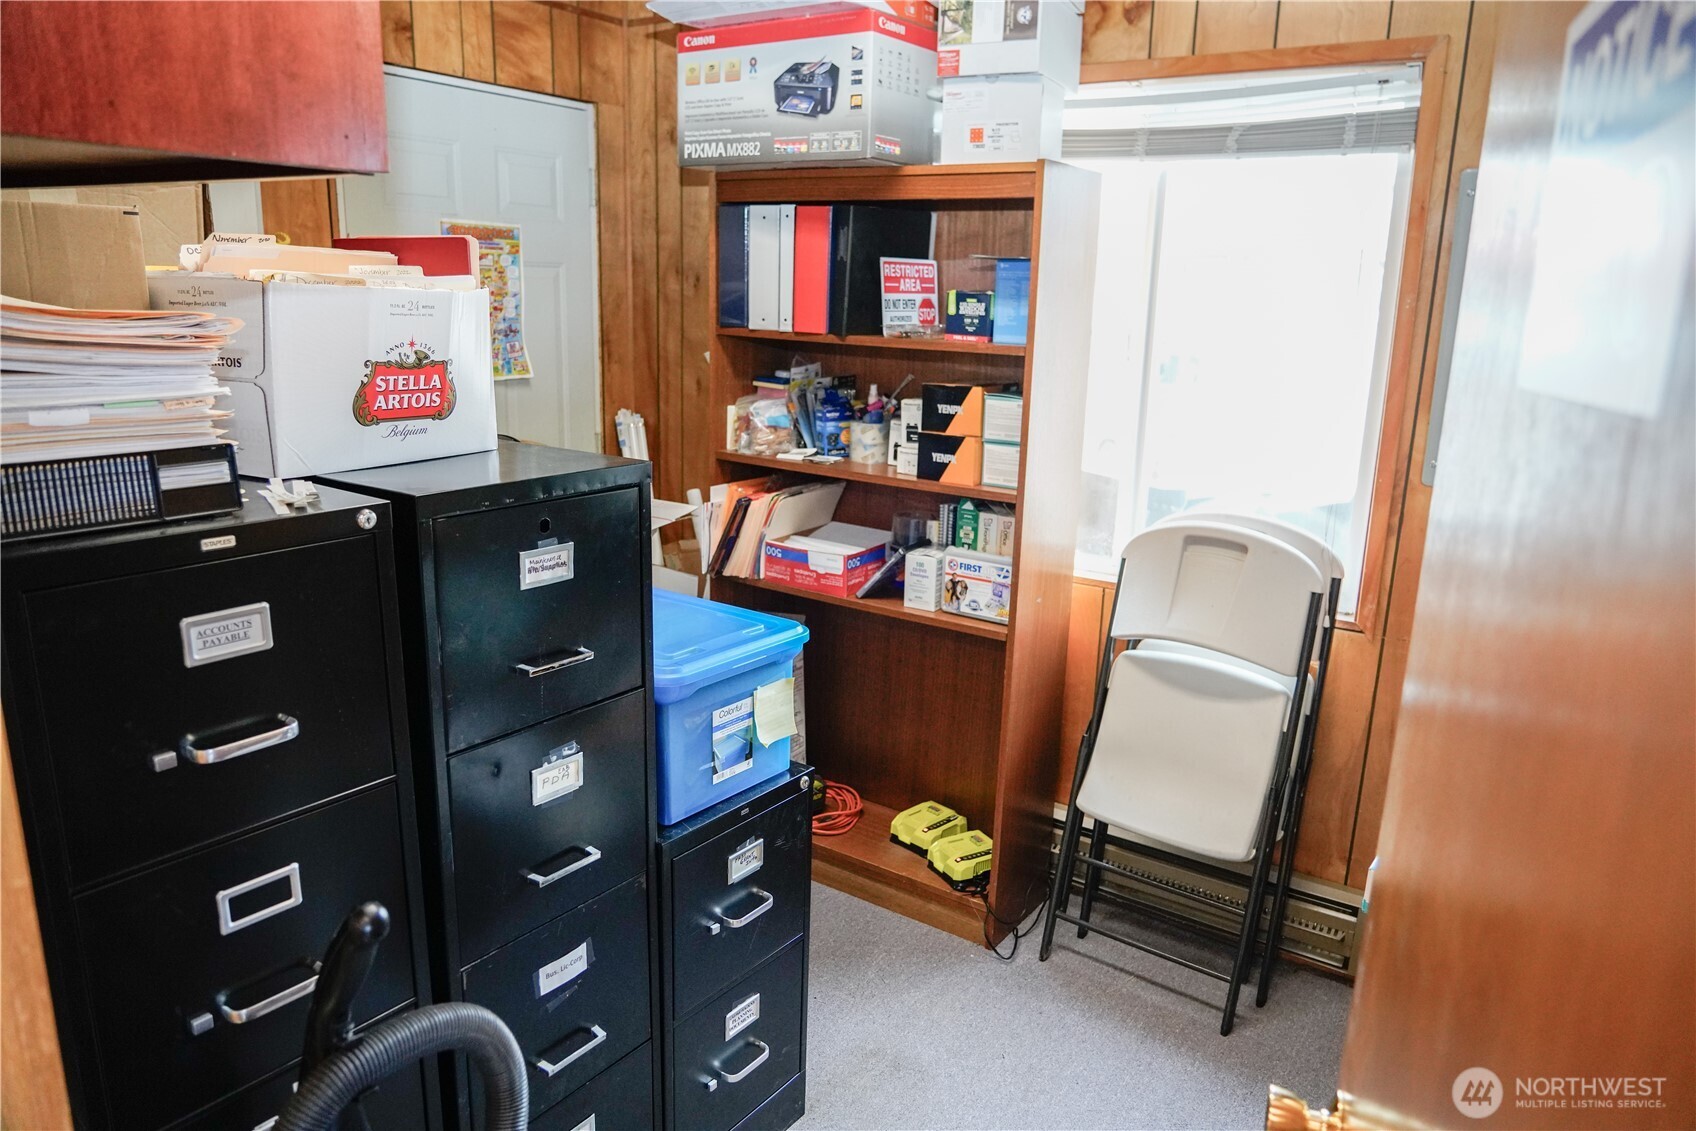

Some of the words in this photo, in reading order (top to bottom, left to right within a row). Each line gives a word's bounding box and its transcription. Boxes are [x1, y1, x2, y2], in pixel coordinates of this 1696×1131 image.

[879, 16, 906, 35] Canon
[684, 35, 715, 47] Canon
[684, 142, 725, 159] PIXMA
[726, 141, 760, 157] MX882
[212, 234, 252, 244] November
[884, 264, 935, 278] RESTRICTED
[899, 278, 922, 291] AREA
[191, 286, 202, 297] 24
[407, 300, 419, 311] 24
[919, 308, 936, 321] STOP
[385, 342, 405, 356] ANNO
[419, 343, 436, 355] 1366
[375, 375, 442, 392] STELLA
[374, 392, 441, 410] ARTOIS
[381, 424, 428, 441] Belgium
[767, 546, 782, 558] 500
[848, 557, 861, 569] 500
[959, 563, 982, 573] FIRST
[197, 619, 252, 638] ACCOUNTS
[202, 631, 250, 648] PAYABLE
[542, 770, 570, 790] PDA
[546, 970, 559, 980] Bus.
